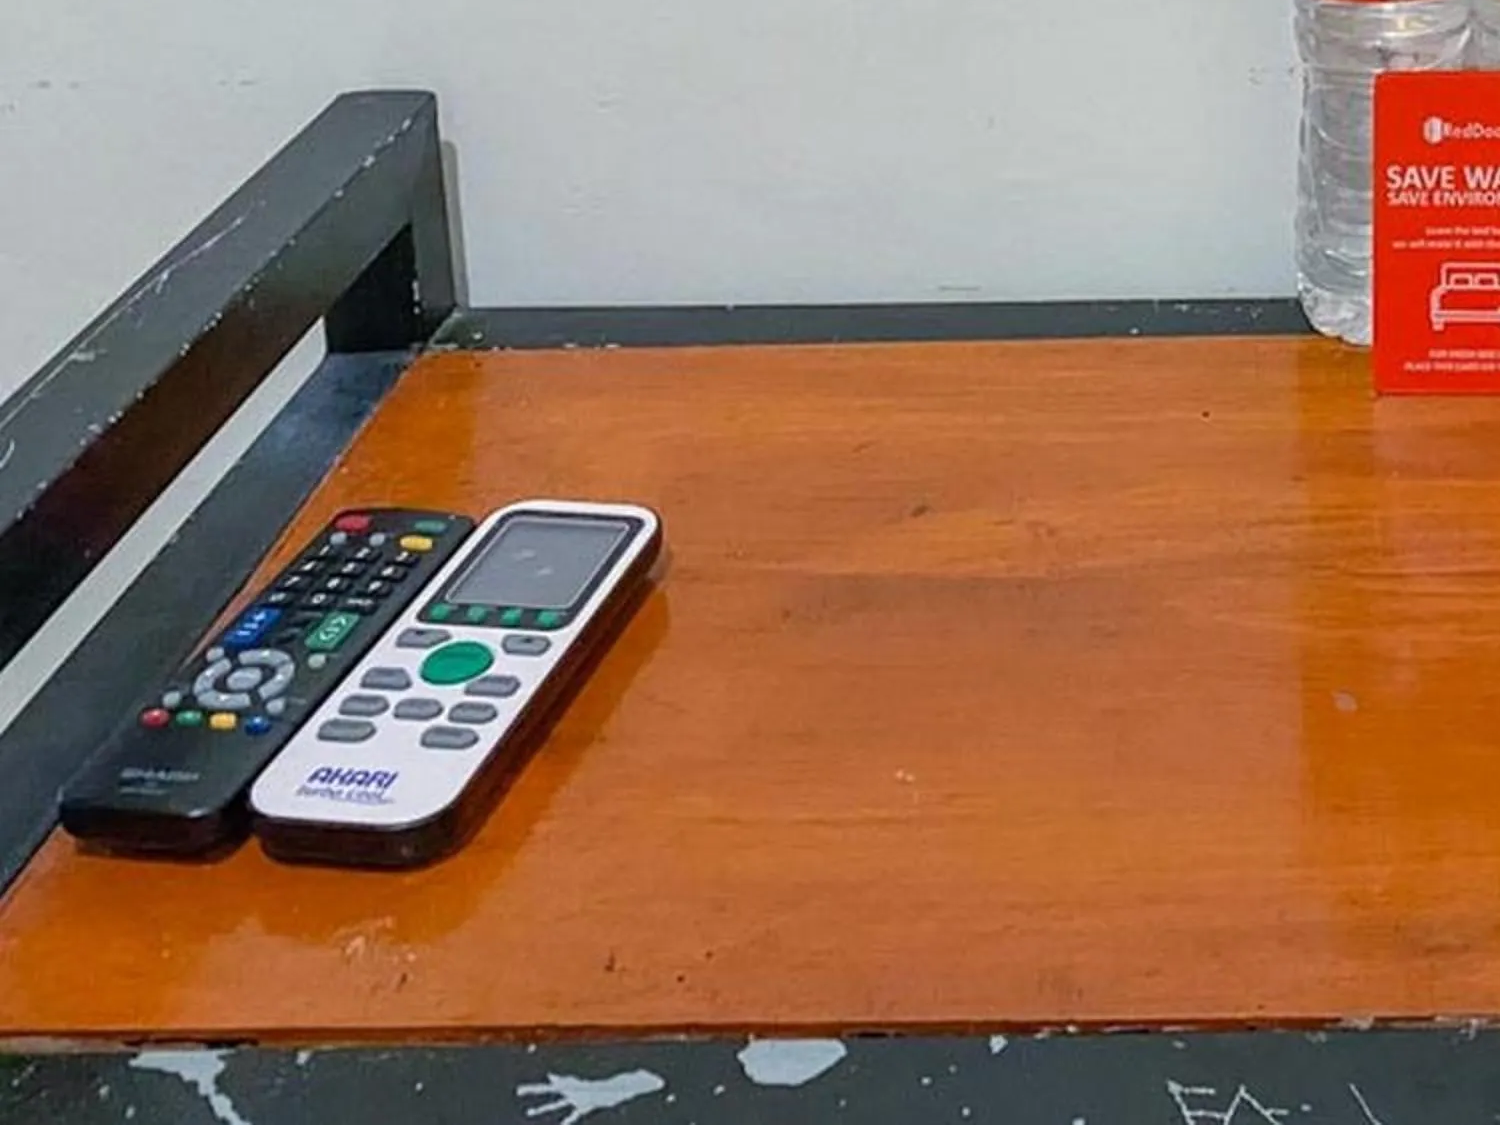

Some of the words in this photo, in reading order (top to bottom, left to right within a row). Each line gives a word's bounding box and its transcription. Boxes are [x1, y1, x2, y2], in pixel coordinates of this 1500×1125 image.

[1386, 165, 1456, 190] SAVE
[1386, 190, 1430, 208] SAVE
[306, 766, 399, 789] AKARI
